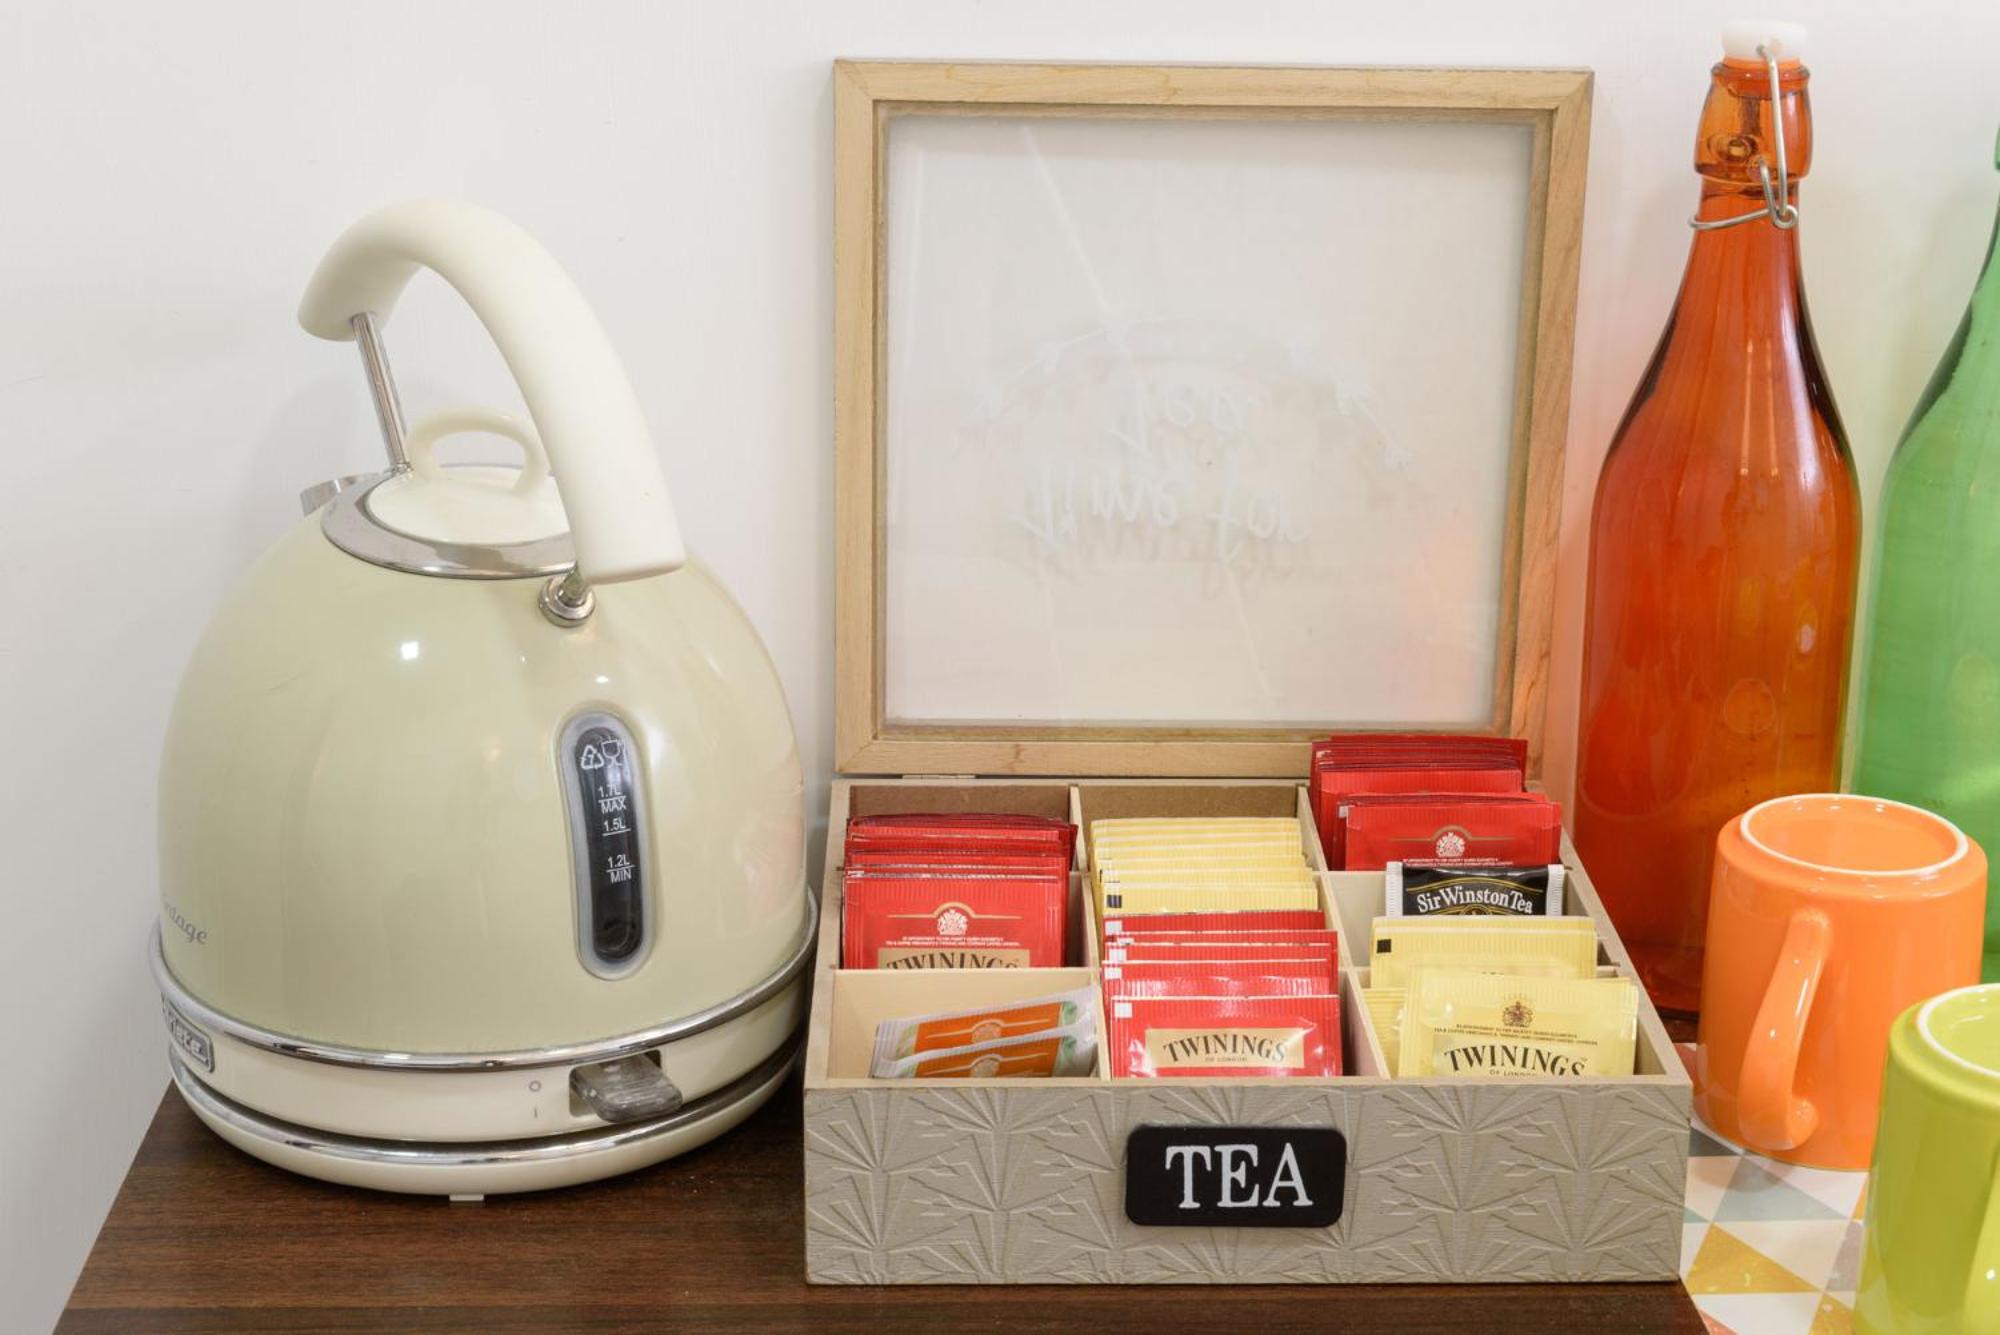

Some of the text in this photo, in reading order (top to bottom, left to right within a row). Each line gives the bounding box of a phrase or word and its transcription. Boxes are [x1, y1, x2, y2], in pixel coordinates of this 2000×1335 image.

[598, 785, 622, 798] 1.7L
[600, 798, 627, 814] MAX
[603, 817, 626, 832] 1.5L
[607, 854, 631, 868] 1.2L
[610, 867, 632, 885] MIN
[1416, 885, 1533, 914] Sir Winston Tea
[1163, 1033, 1288, 1063] TWININGS
[1444, 1045, 1586, 1076] TWININGS
[1165, 1142, 1314, 1209] TEA
